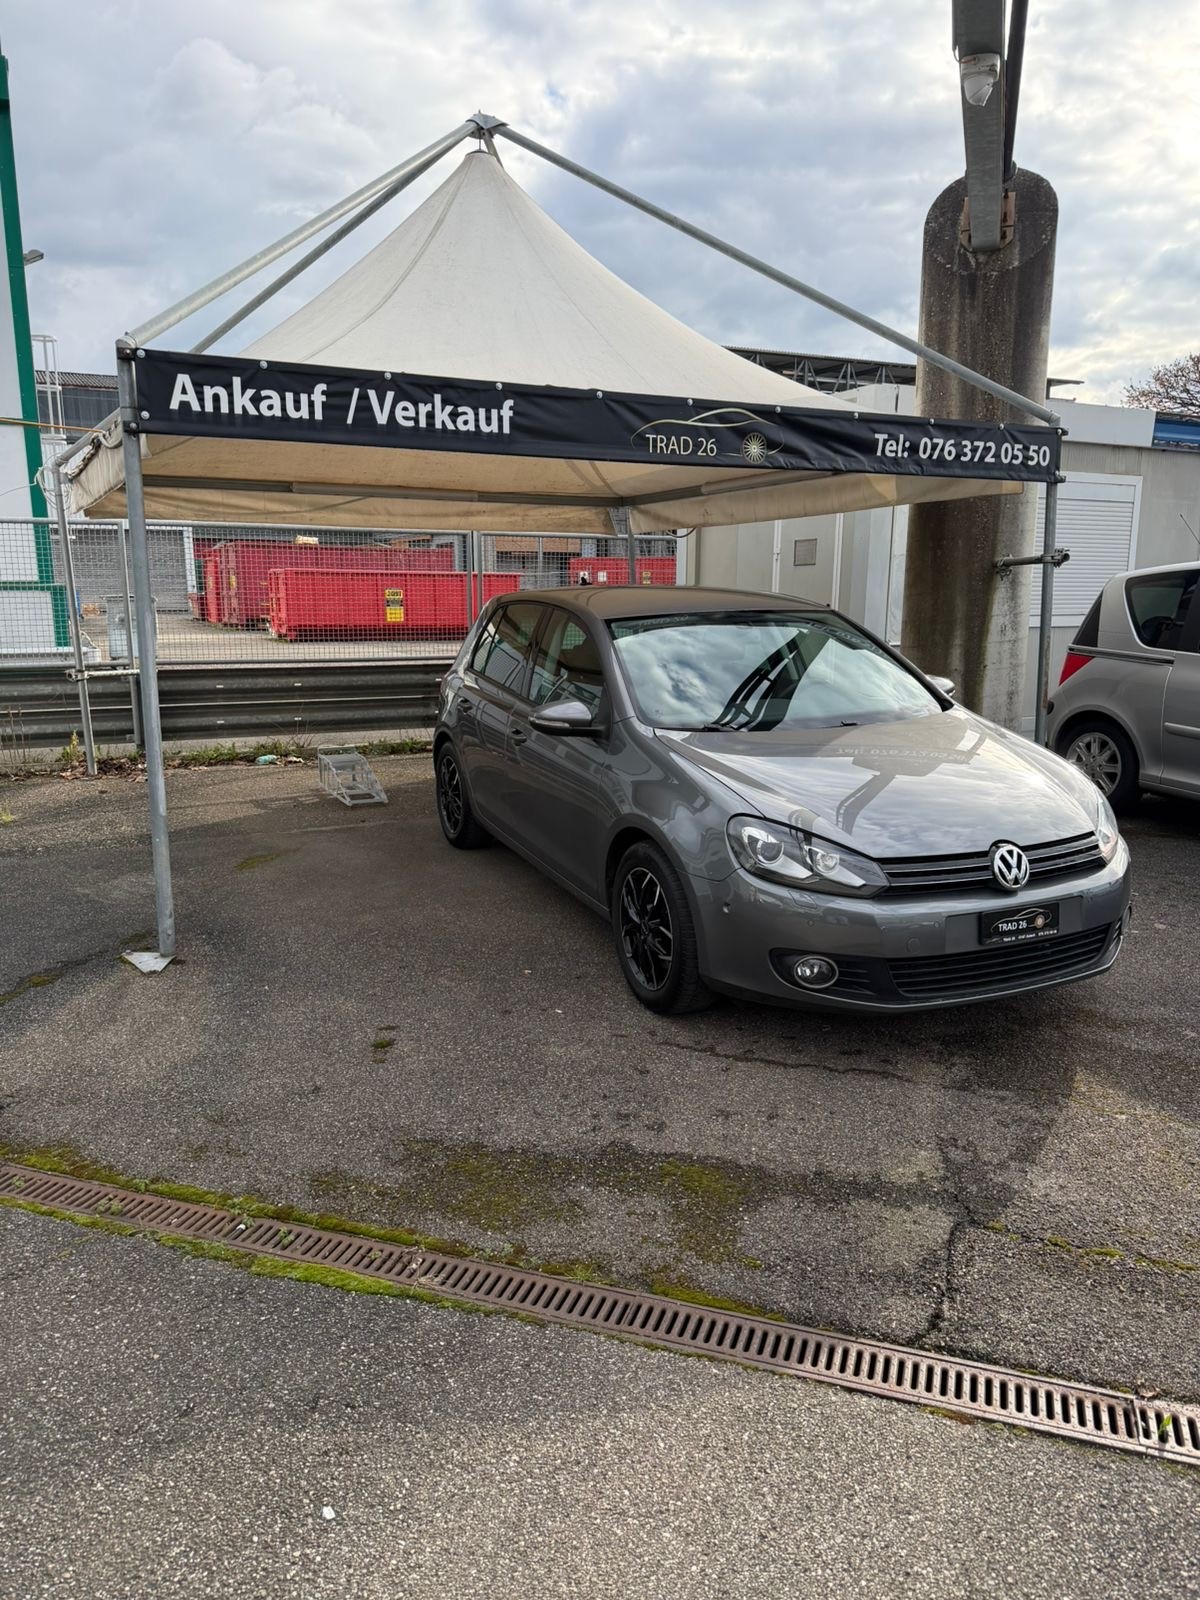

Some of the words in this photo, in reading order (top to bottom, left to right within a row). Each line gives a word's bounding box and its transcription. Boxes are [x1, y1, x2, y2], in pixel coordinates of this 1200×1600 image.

[169, 373, 327, 421] Ankauf
[645, 434, 693, 456] TRAD
[697, 438, 718, 457] 26
[874, 432, 910, 459] Tel:
[918, 438, 956, 462] 076
[960, 440, 996, 464] 372
[1001, 442, 1024, 466] 05
[1027, 443, 1051, 467] 50
[998, 922, 1018, 932] TRAD
[1018, 920, 1027, 929] 26
